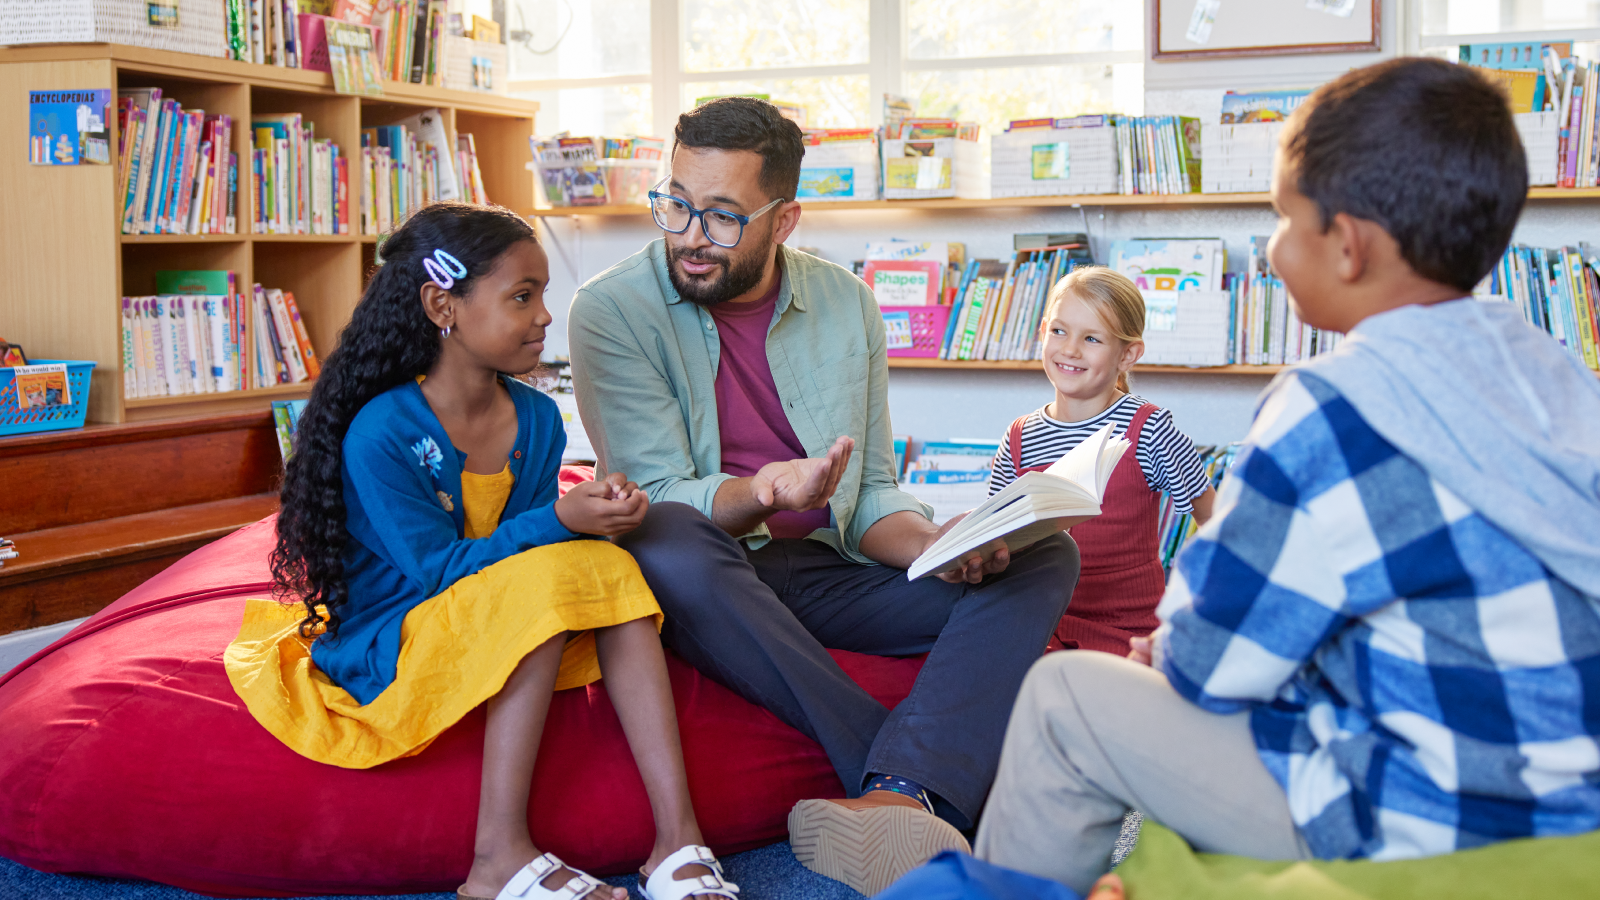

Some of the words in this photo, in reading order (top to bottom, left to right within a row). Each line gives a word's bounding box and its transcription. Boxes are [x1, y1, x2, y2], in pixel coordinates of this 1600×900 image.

[30, 93, 95, 104] ENCYCLOPEDIAS
[178, 284, 207, 292] Questions
[143, 330, 156, 370] BUGS
[152, 323, 164, 379] HISTORY
[170, 323, 181, 375] ANIMALS
[178, 323, 190, 371] HISTORY
